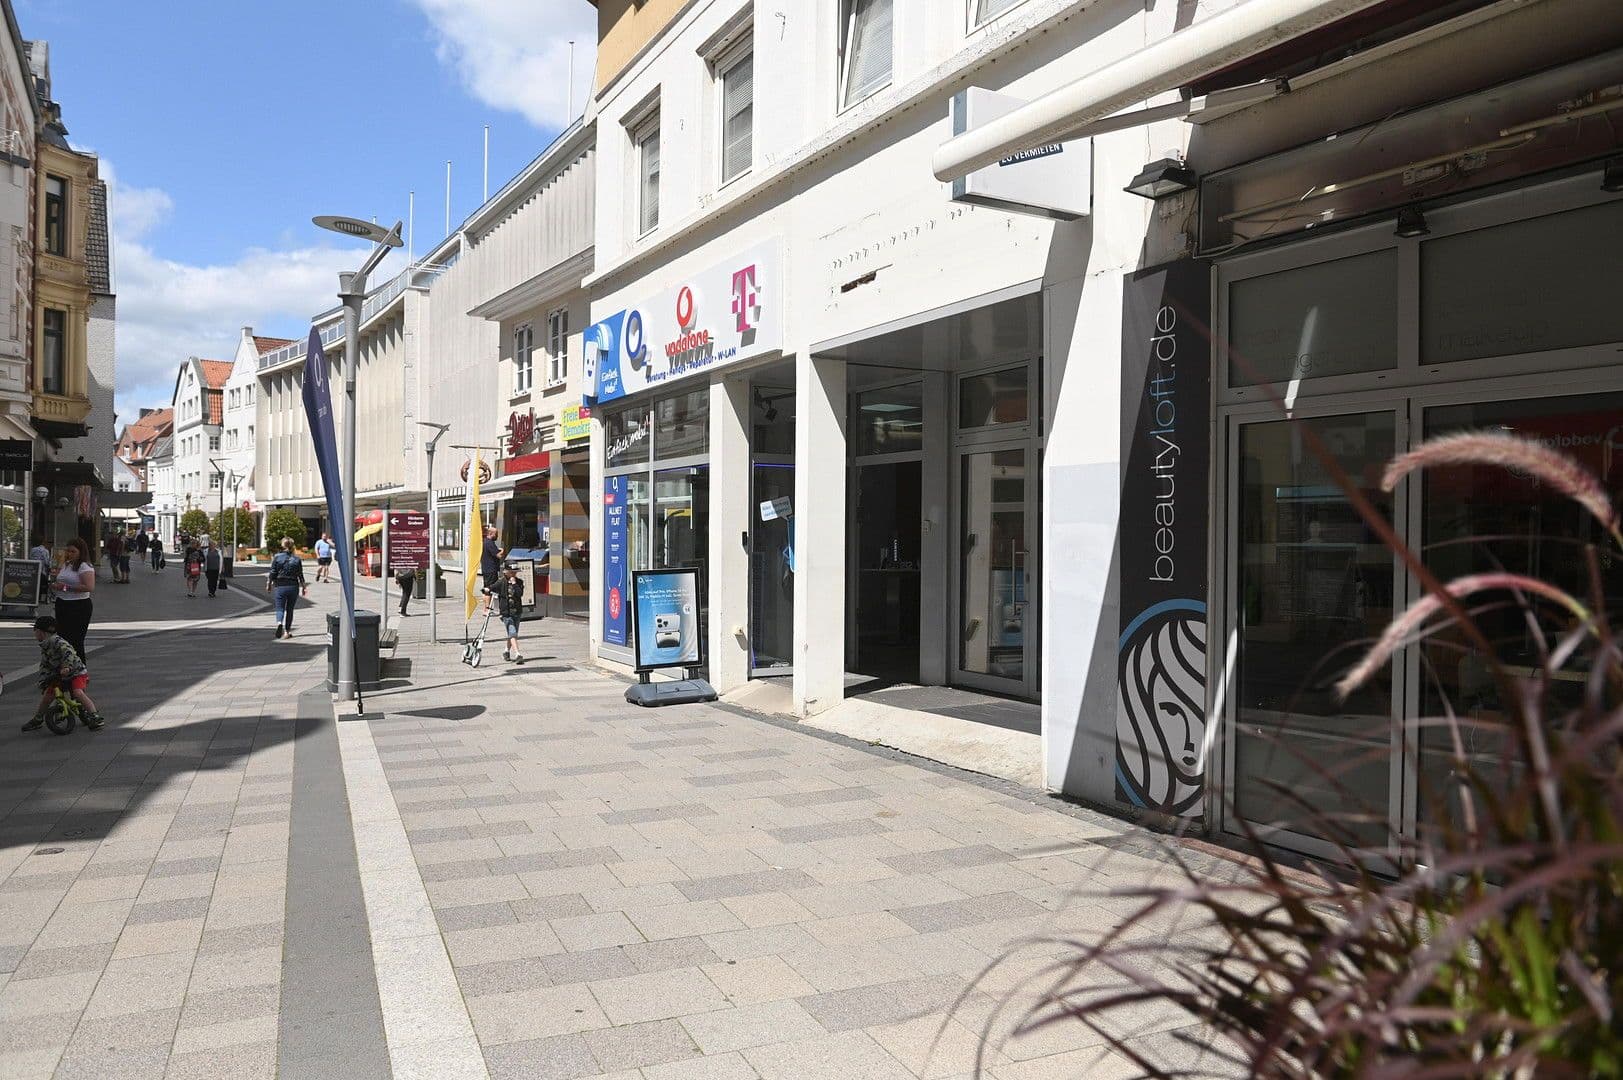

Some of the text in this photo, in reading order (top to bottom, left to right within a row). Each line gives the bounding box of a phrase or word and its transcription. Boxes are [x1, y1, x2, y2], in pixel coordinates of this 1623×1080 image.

[665, 329, 709, 357] vodafone
[718, 346, 737, 361] W-LAN
[1149, 305, 1181, 582] beautyloft.de
